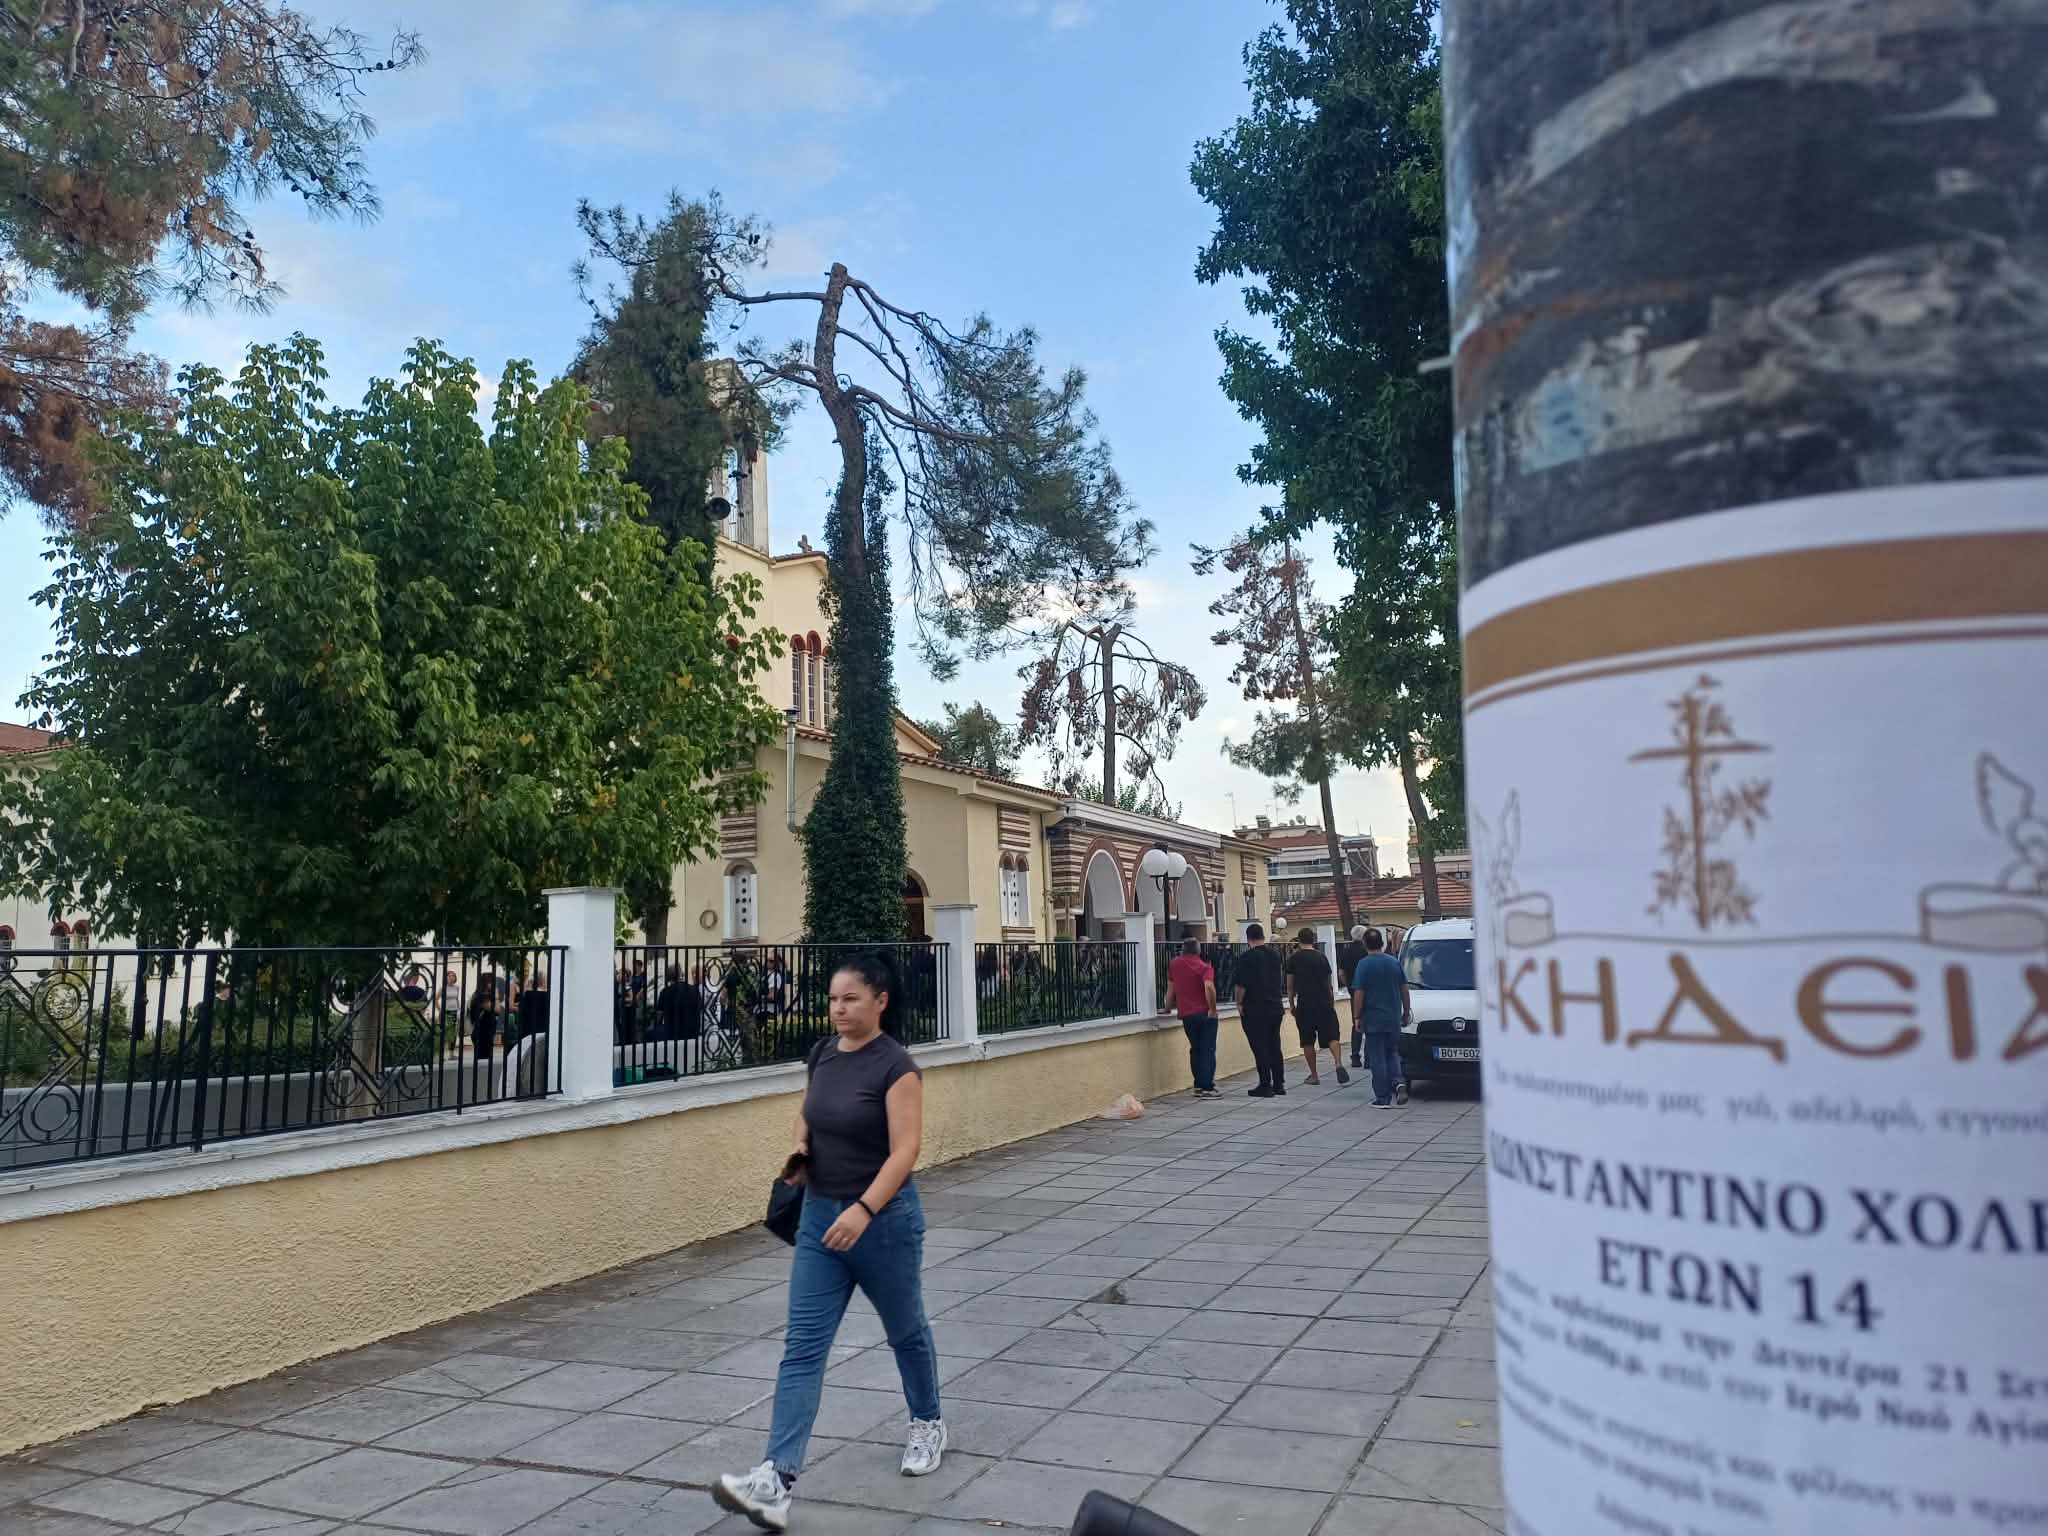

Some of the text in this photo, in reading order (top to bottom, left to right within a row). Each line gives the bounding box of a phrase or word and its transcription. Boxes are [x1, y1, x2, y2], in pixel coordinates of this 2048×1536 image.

[1597, 1234, 1764, 1317] ΕΤΩΝ
[1790, 1274, 1885, 1334] 14
[1754, 1338, 1900, 1389] Δευτέρα
[1926, 1362, 1970, 1396] 21
[1786, 1381, 1861, 1424] Ιερό
[1876, 1396, 1952, 1433] Ναό
